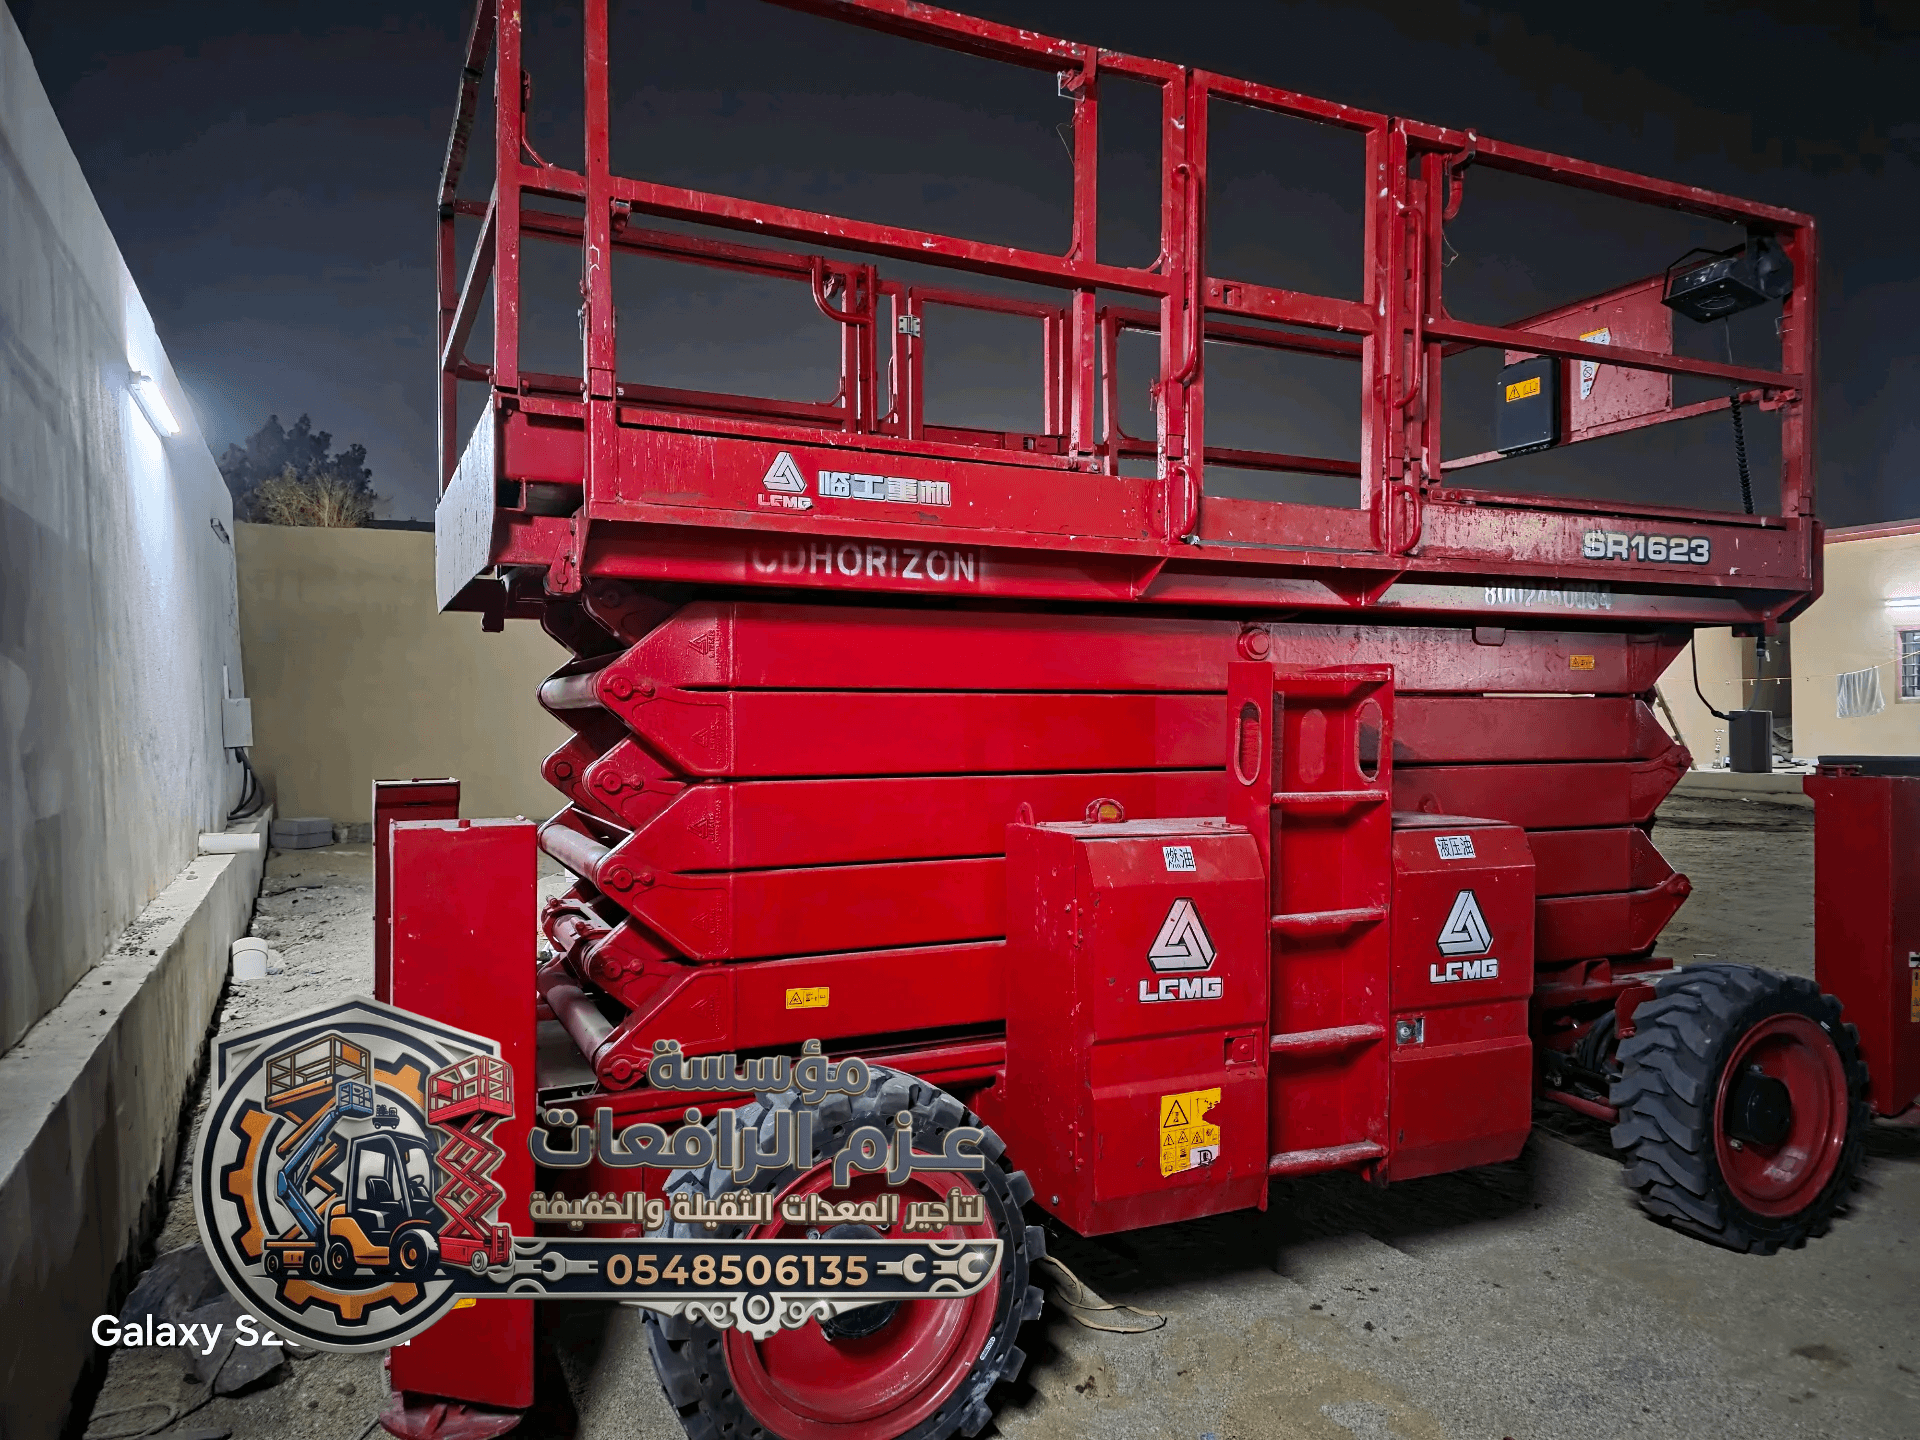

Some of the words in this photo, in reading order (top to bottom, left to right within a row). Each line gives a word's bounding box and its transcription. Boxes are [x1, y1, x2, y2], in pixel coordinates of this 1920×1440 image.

[818, 471, 950, 505] 临工重机
[1584, 531, 1709, 563] SR1623
[1438, 837, 1475, 857] 液压油
[1430, 959, 1498, 983] LGMG
[1138, 977, 1222, 1003] LGMG
